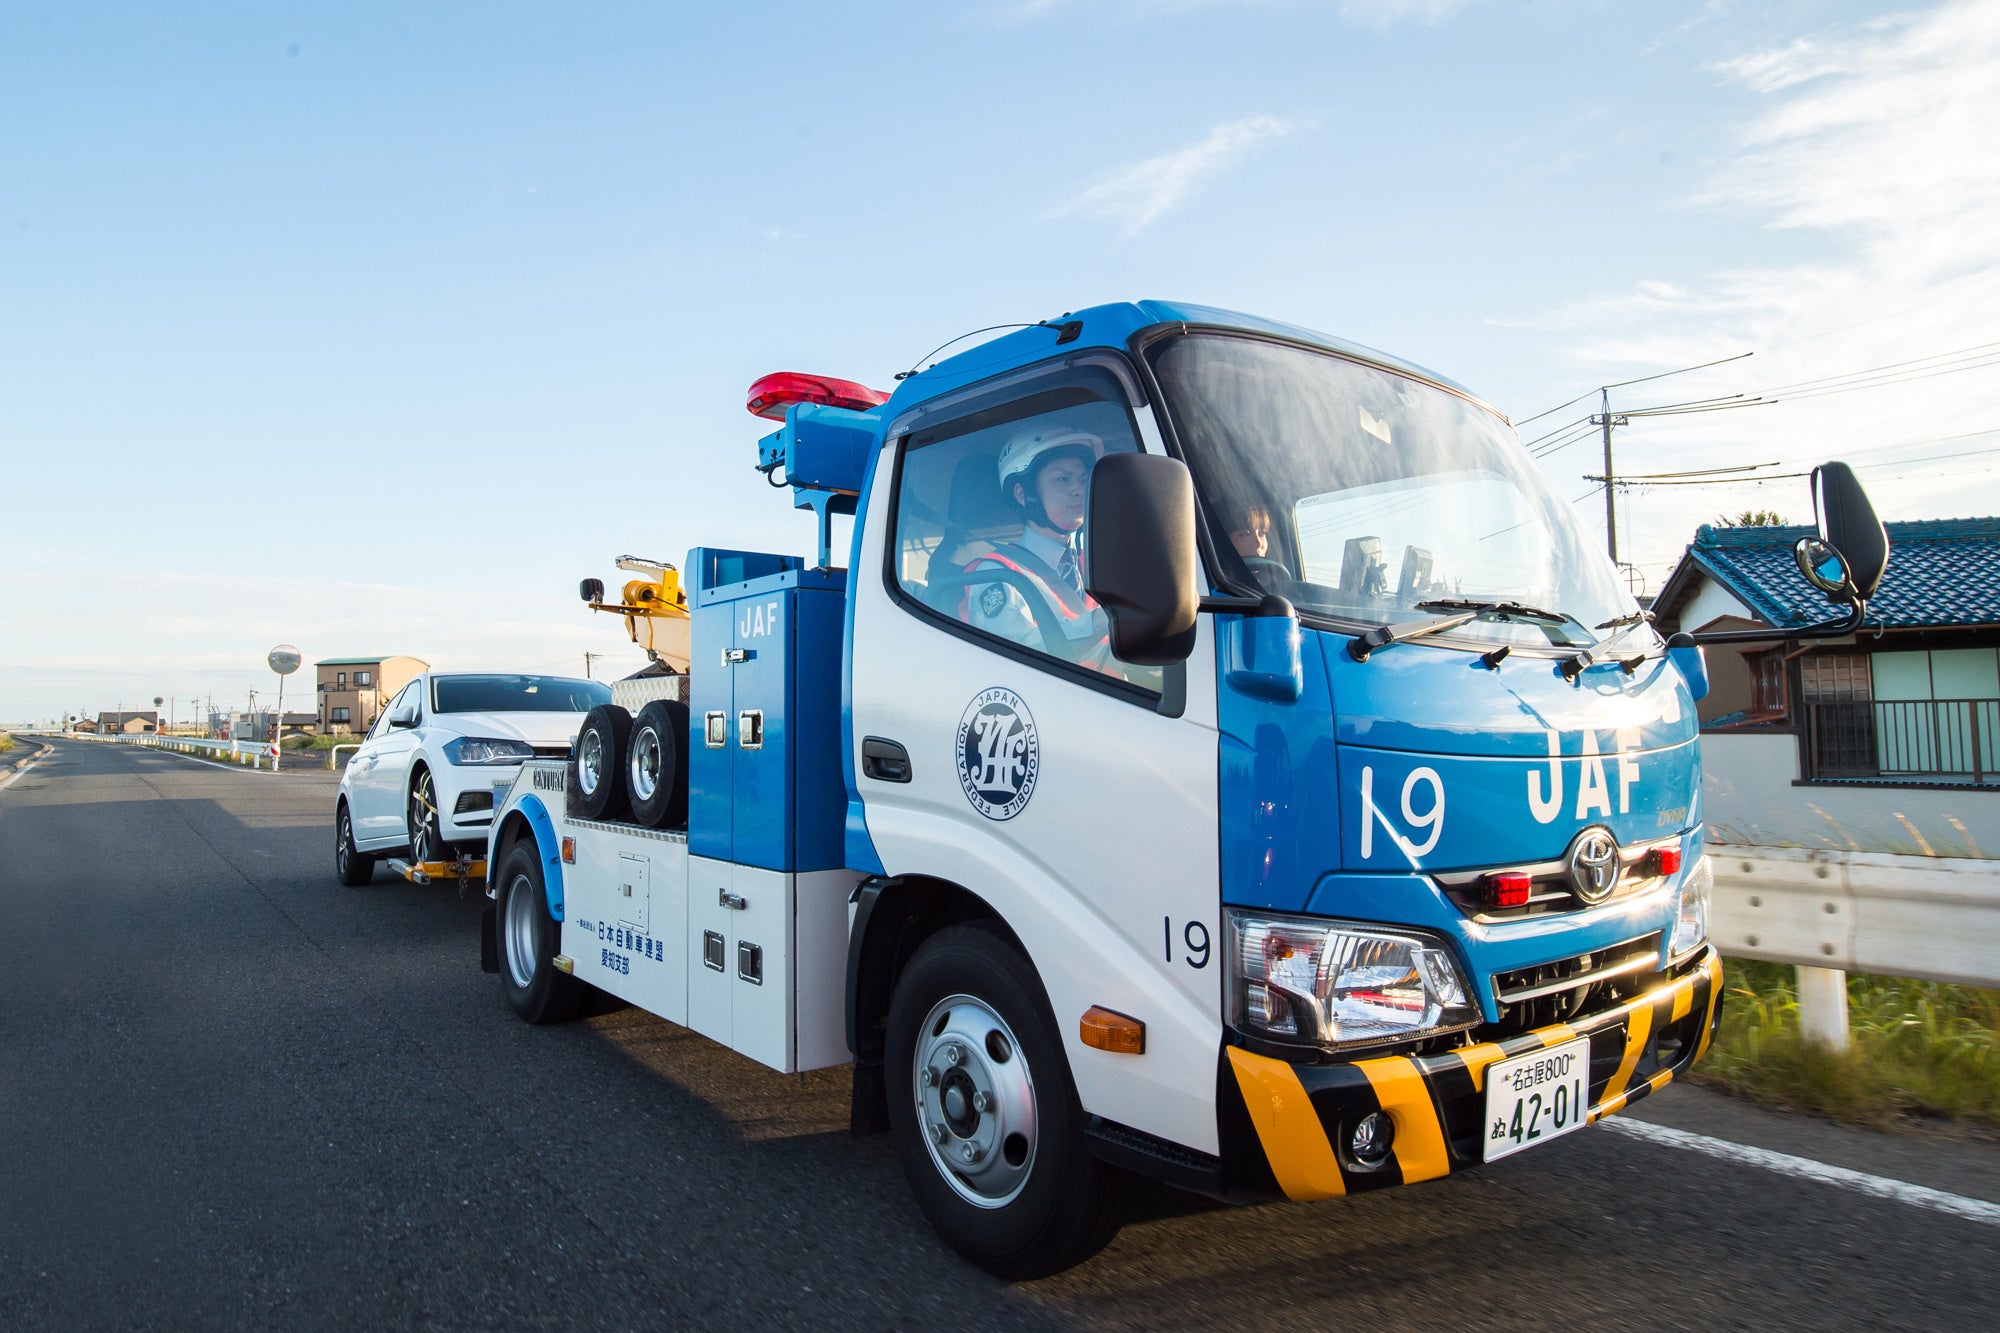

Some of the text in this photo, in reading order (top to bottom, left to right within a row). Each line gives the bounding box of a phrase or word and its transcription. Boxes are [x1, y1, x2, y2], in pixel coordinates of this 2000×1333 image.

[741, 602, 778, 639] JAF
[958, 690, 1036, 816] JAPAN AUTOMOBILE FEDERATION
[1527, 727, 1642, 824] JAF
[533, 767, 564, 791] CENTURY
[1361, 766, 1445, 859] 19
[1656, 806, 1686, 828] DYNA
[598, 920, 664, 962] 日本自動車連盟
[601, 948, 629, 975] 愛知支部
[1164, 915, 1211, 970] 19
[1509, 1078, 1581, 1144] 42-01
